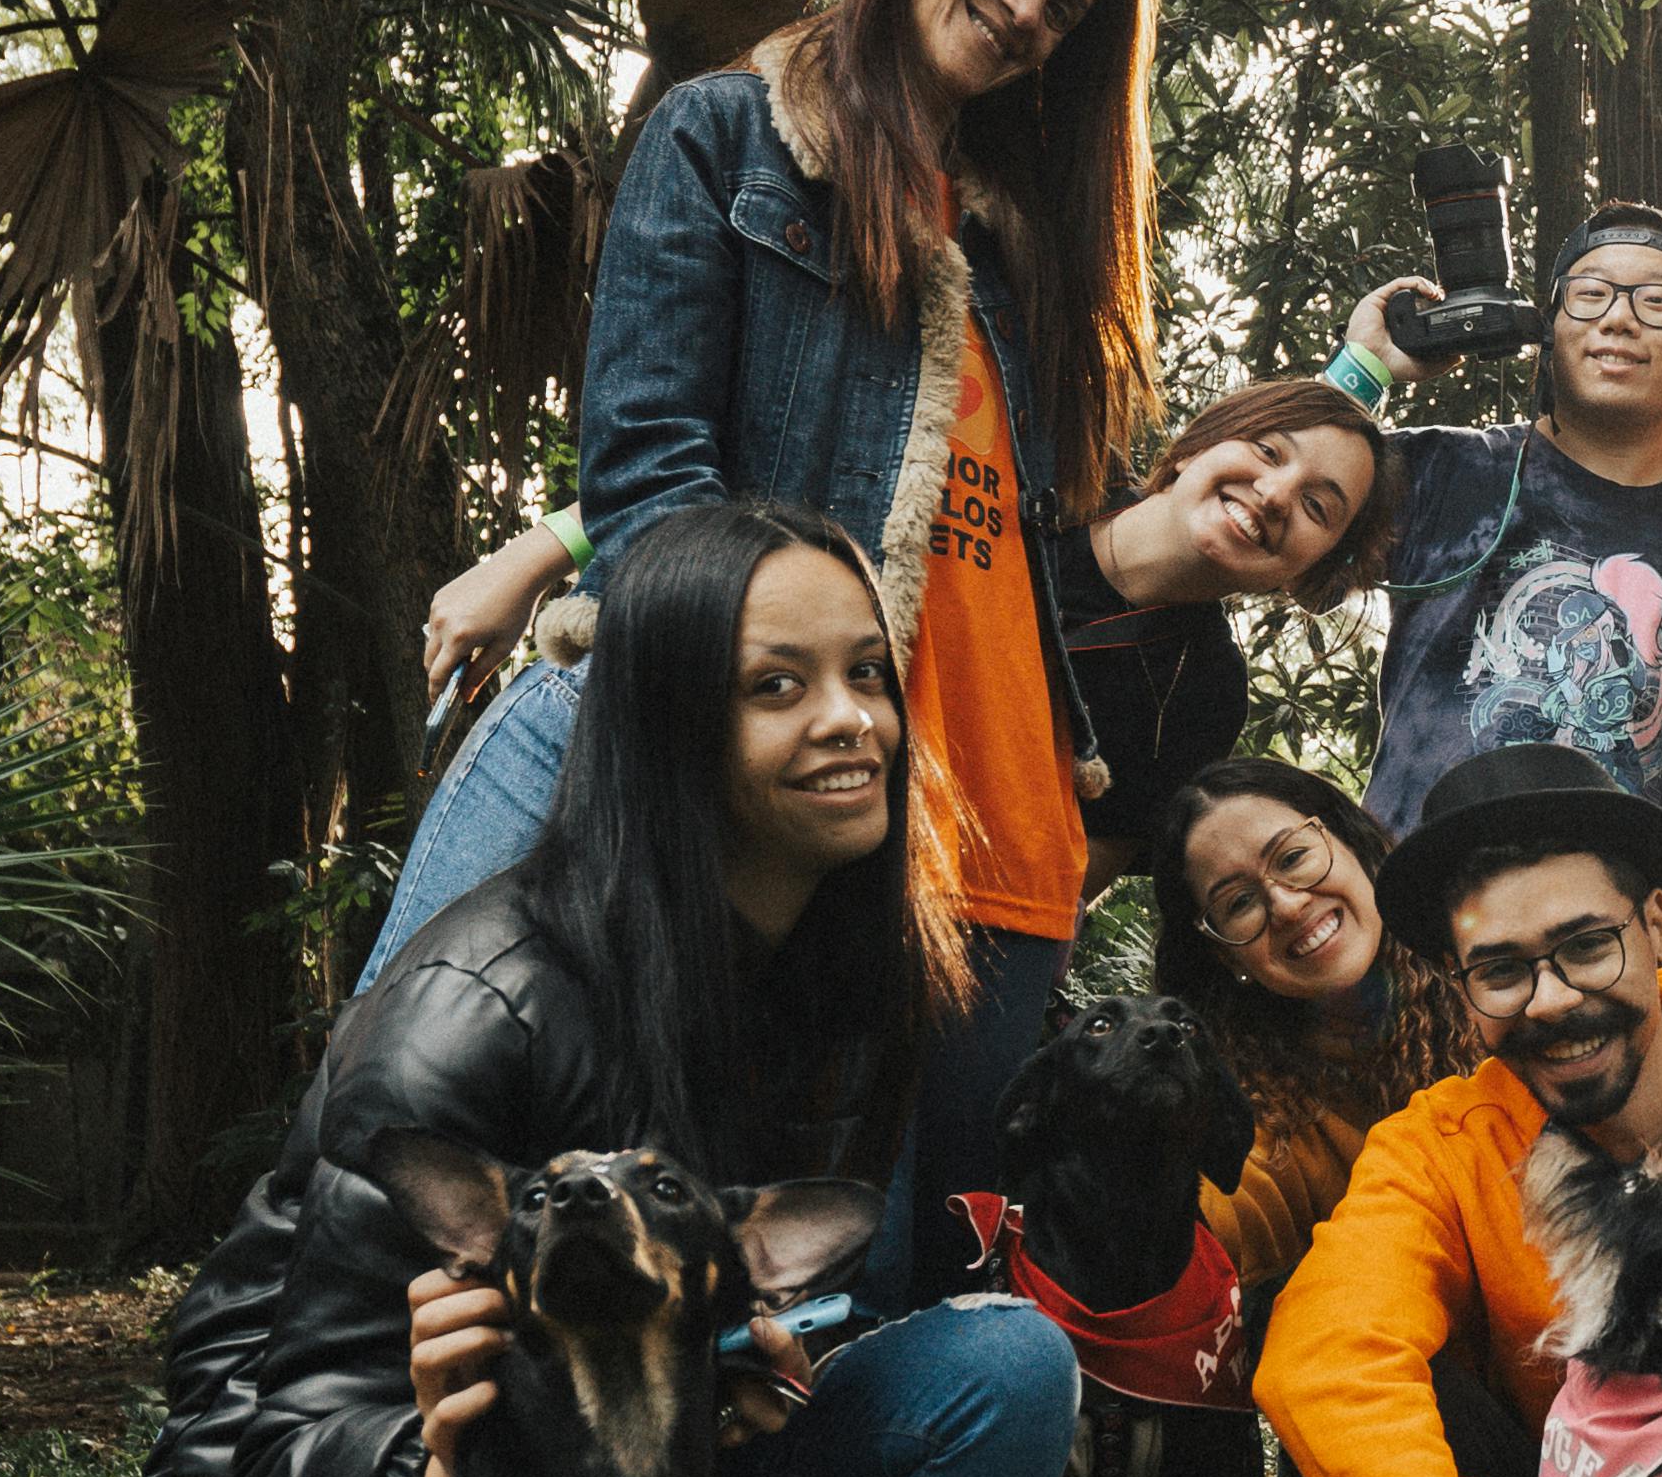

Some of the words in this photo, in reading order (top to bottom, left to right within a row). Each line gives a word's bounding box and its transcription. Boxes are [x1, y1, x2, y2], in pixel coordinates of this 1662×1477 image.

[948, 452, 1000, 501] OR
[941, 489, 1002, 538] LOS
[929, 524, 992, 571] ETS
